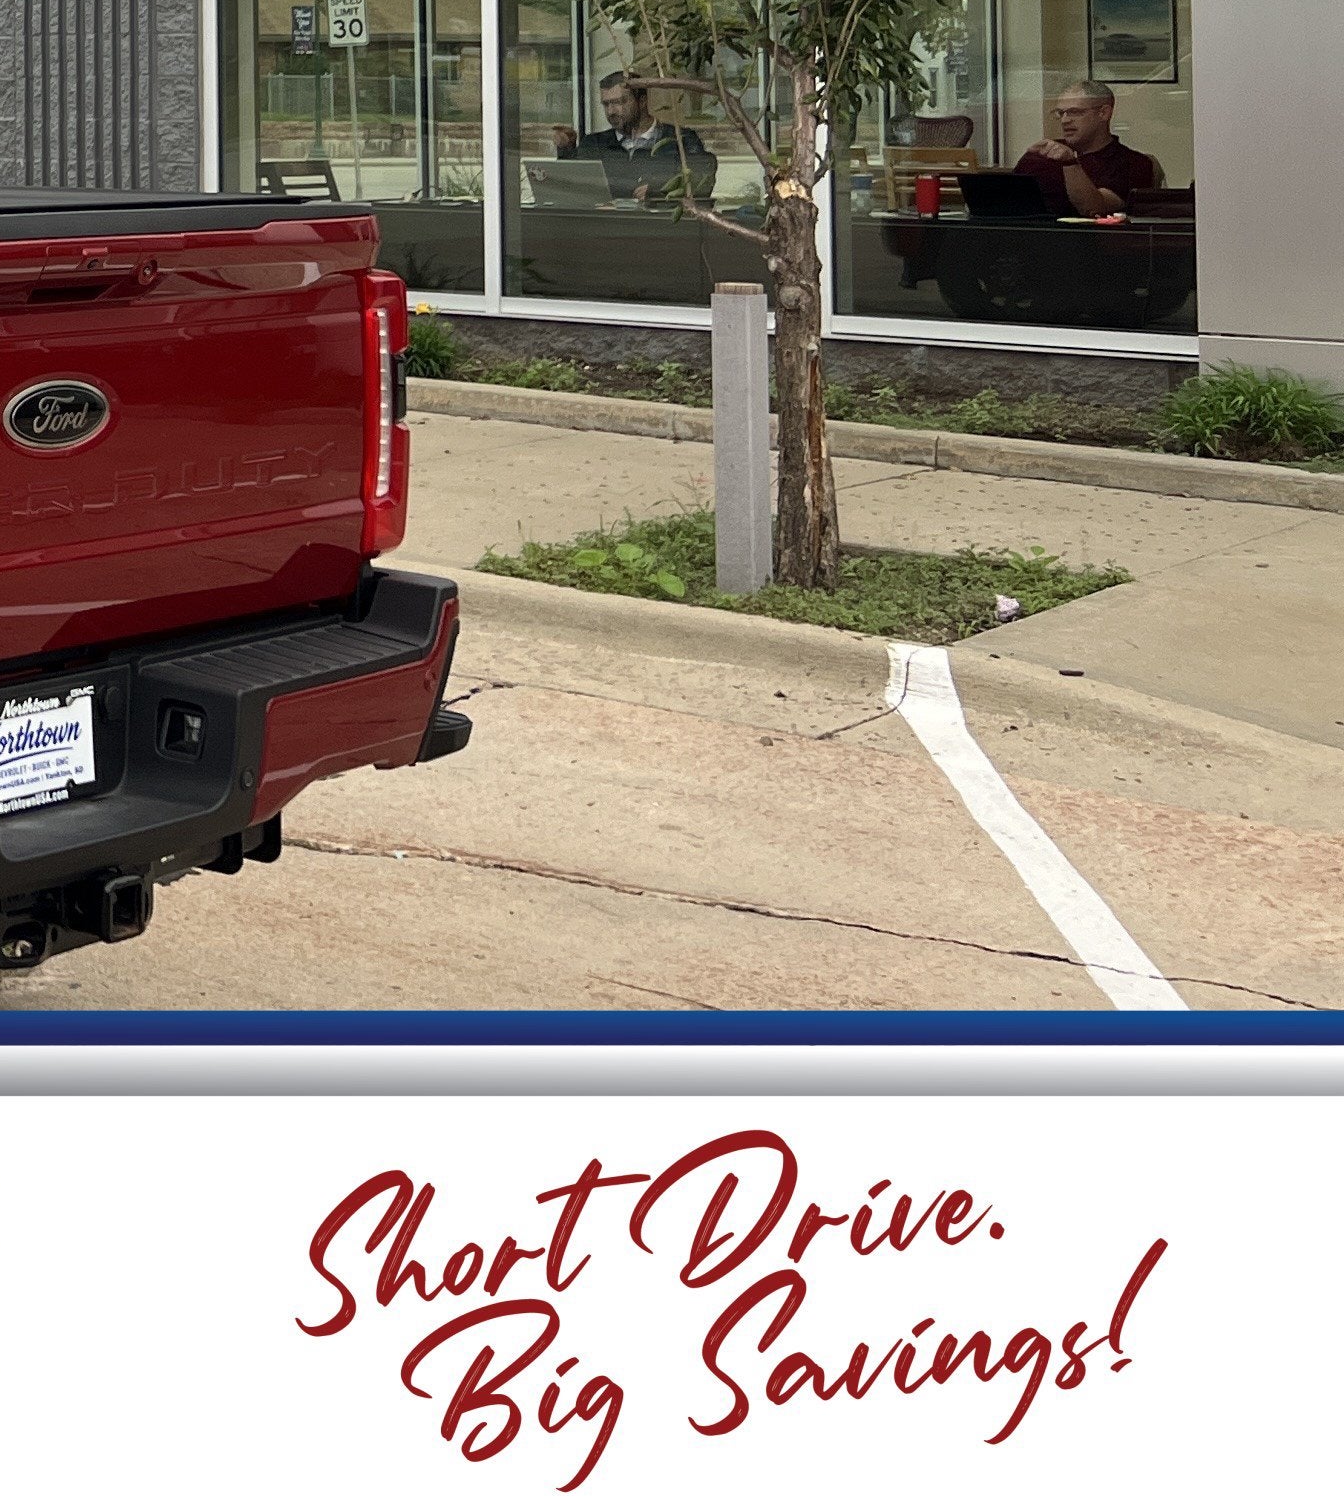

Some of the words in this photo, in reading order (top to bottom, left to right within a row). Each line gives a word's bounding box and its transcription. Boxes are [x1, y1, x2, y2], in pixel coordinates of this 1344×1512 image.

[334, 7, 359, 17] LIMIT
[333, 19, 363, 38] 30
[33, 396, 89, 434] Ford
